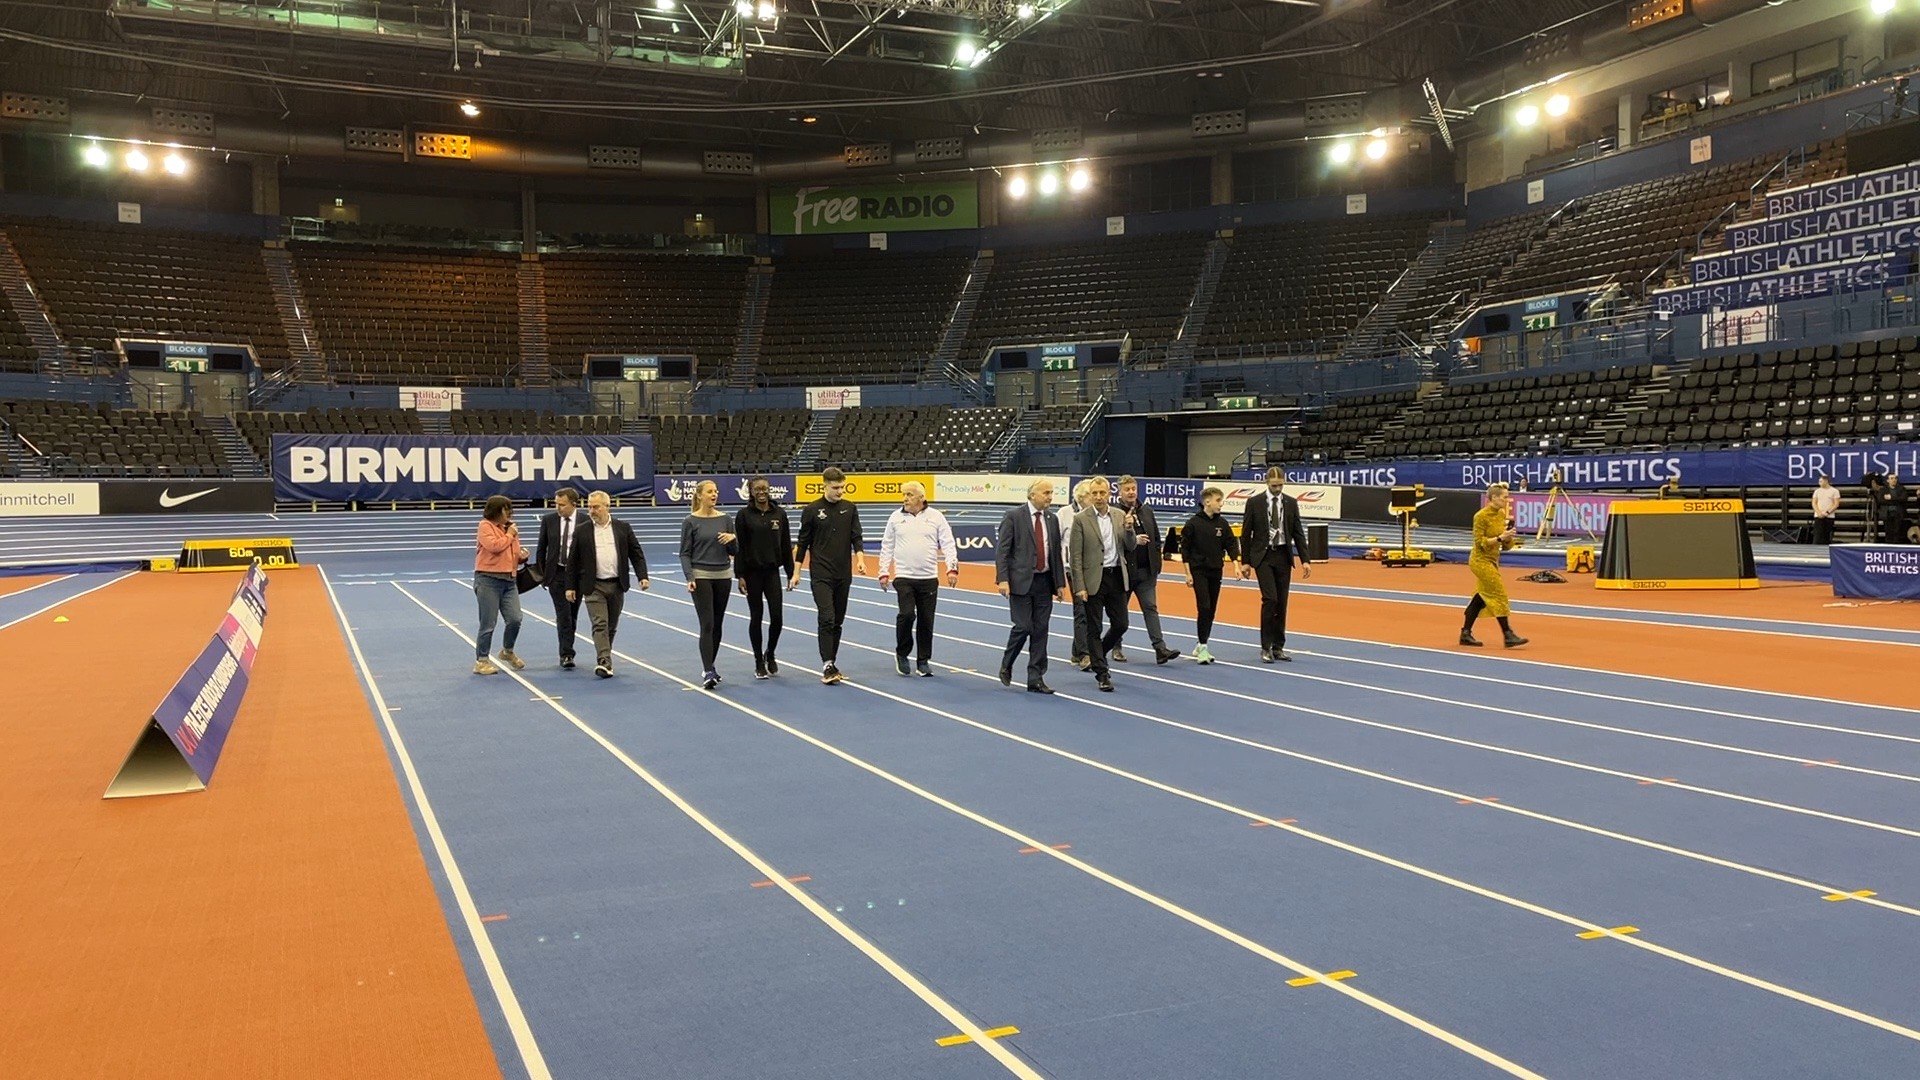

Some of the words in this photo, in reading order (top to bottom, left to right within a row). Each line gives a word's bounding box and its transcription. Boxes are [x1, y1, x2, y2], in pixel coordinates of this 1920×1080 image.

[1769, 183, 1856, 217] BRITISH
[793, 186, 859, 234] Free
[860, 195, 955, 221] RADIO
[1734, 214, 1820, 249] BRITISH
[1696, 250, 1780, 281] BRITISH
[1746, 263, 1890, 302] ATHLETICS
[1528, 300, 1550, 310] BLOCK
[169, 345, 196, 353] BLOCK
[416, 390, 441, 399] tilita
[290, 446, 635, 483] BIRMINGHAM
[1788, 450, 1917, 479] BRITISH
[1462, 463, 1541, 485] BRITISH
[1544, 458, 1681, 483] ATHLETICS
[805, 483, 857, 494] SEO
[1146, 483, 1196, 496] BRITISH
[1144, 496, 1196, 507] ATHLETICS
[1683, 502, 1732, 512] SEIKO
[229, 547, 254, 558] 60m
[1864, 552, 1918, 564] BRITISH
[1864, 564, 1919, 574] ATHLETICS
[1632, 581, 1667, 589] SEIKO
